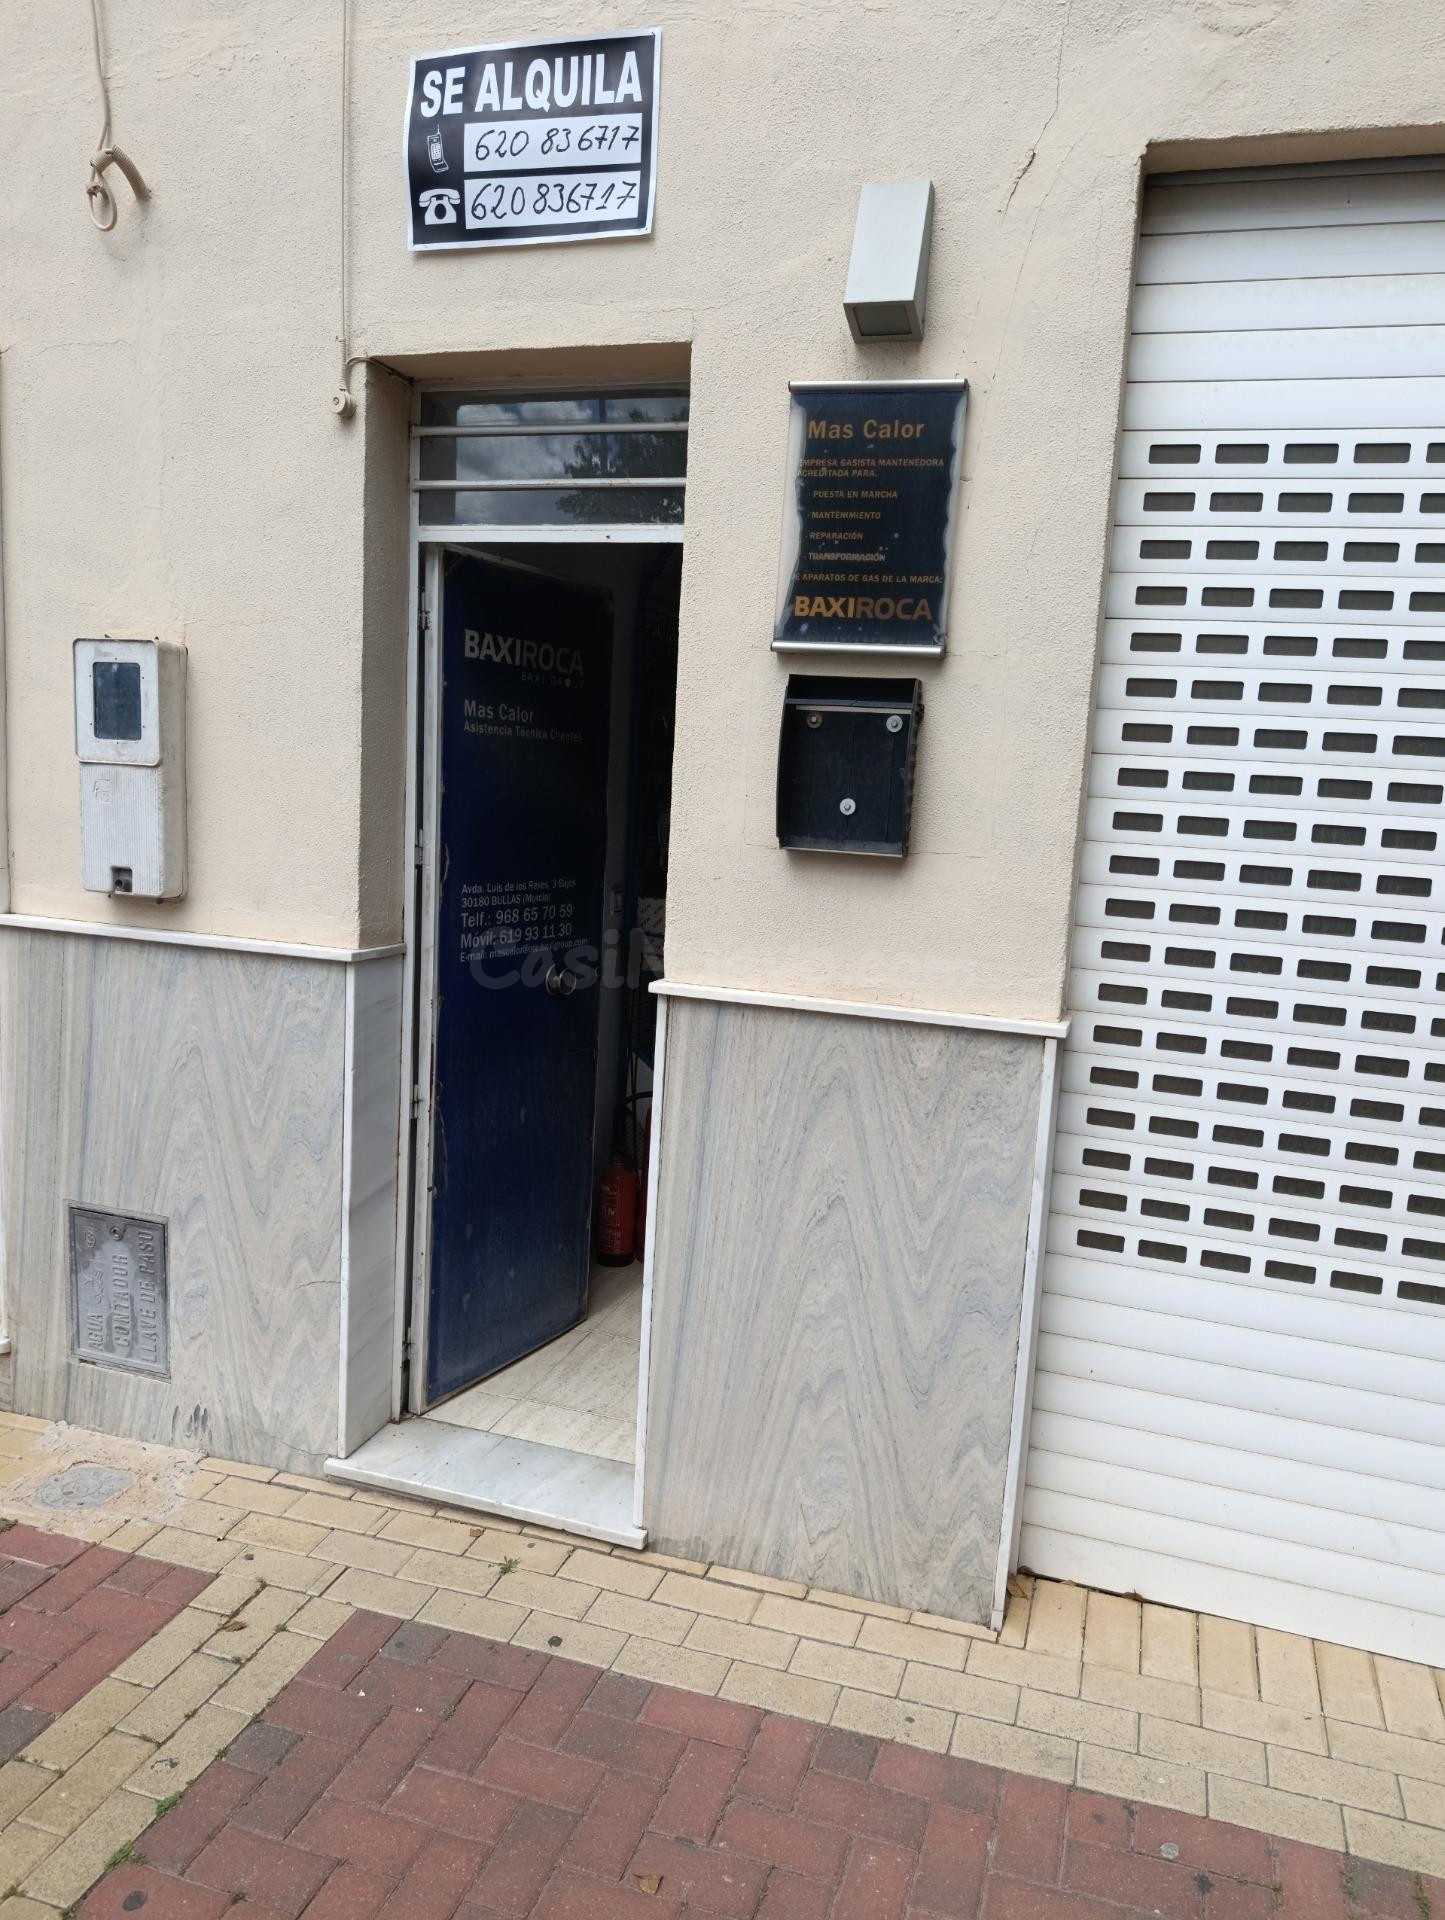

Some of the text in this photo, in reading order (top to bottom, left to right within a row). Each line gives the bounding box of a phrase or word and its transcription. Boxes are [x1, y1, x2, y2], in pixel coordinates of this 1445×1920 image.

[420, 50, 643, 118] SE ALQUILA
[475, 130, 529, 160] 620
[808, 419, 925, 439] Mas Calor
[840, 458, 876, 467] GASISTA
[878, 458, 944, 467] MANTENEDORA
[813, 490, 898, 499] PUESTA EN MARCHA
[811, 511, 881, 520] MANTENIMIENTO
[809, 531, 864, 541] REPARACIÓN
[802, 573, 846, 582] APARATOS
[848, 574, 860, 582] DE
[862, 574, 880, 583] GAS
[882, 575, 893, 583] DE
[896, 575, 907, 583] LA
[909, 575, 943, 584] MARCA:
[794, 595, 933, 621] BAXIROCA
[464, 628, 585, 677] BAXIROCA
[464, 699, 535, 723] Mas Calor
[464, 720, 513, 736] Asistencia
[487, 883, 503, 893] Luis
[504, 882, 515, 892] de
[552, 879, 557, 889] 3
[462, 897, 490, 909] 30180
[491, 894, 522, 907] BULLAS
[461, 903, 573, 929] Telf.: 968 65 70 59
[460, 922, 573, 949] Móvil: 619 93 11 30
[112, 1254, 130, 1348] CONTADOR
[137, 1229, 158, 1364] LLAVE DE PASO
